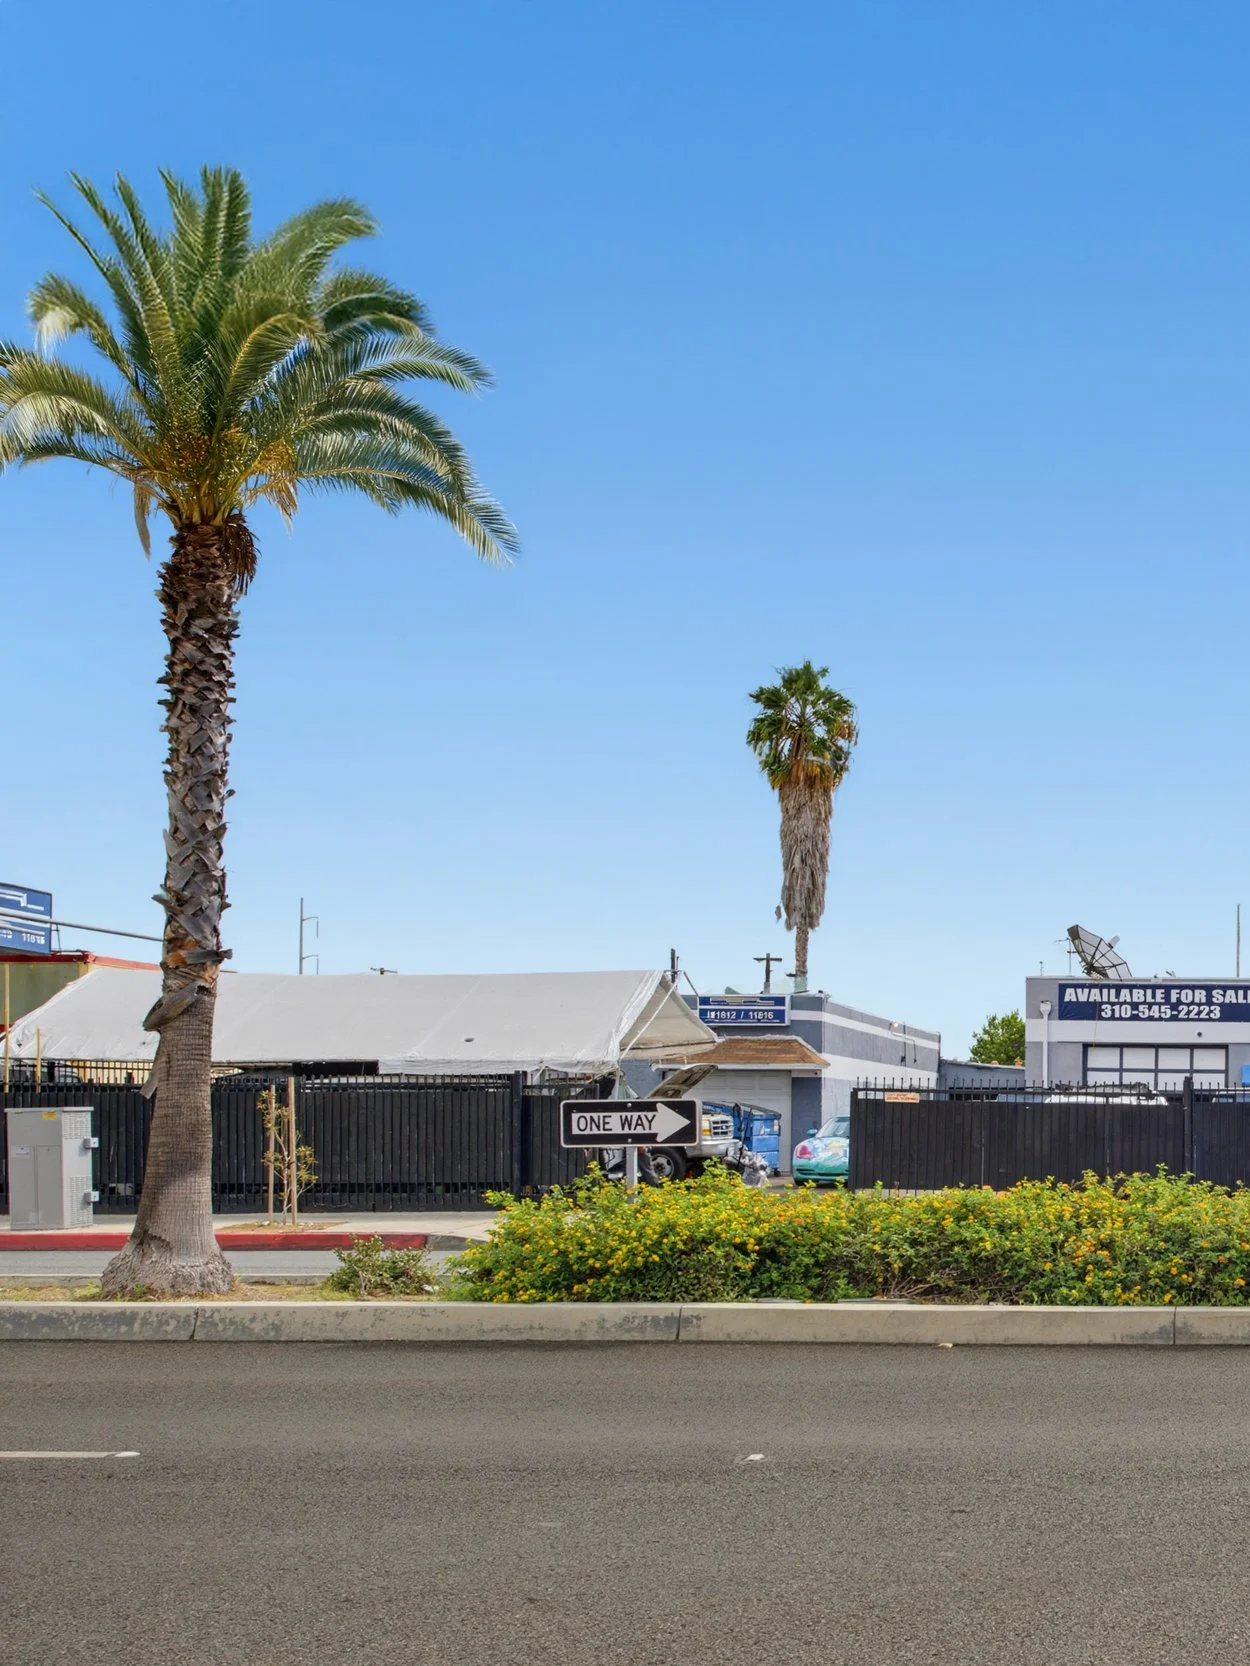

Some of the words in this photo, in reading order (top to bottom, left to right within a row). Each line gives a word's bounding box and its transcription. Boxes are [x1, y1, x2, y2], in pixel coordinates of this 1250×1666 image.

[1064, 988, 1165, 1003] AVAILABLE
[1171, 989, 1207, 1004] FOR
[1101, 1004, 1221, 1019] 310-545-2223
[577, 1115, 613, 1132] ONE
[619, 1114, 657, 1131] WAY
